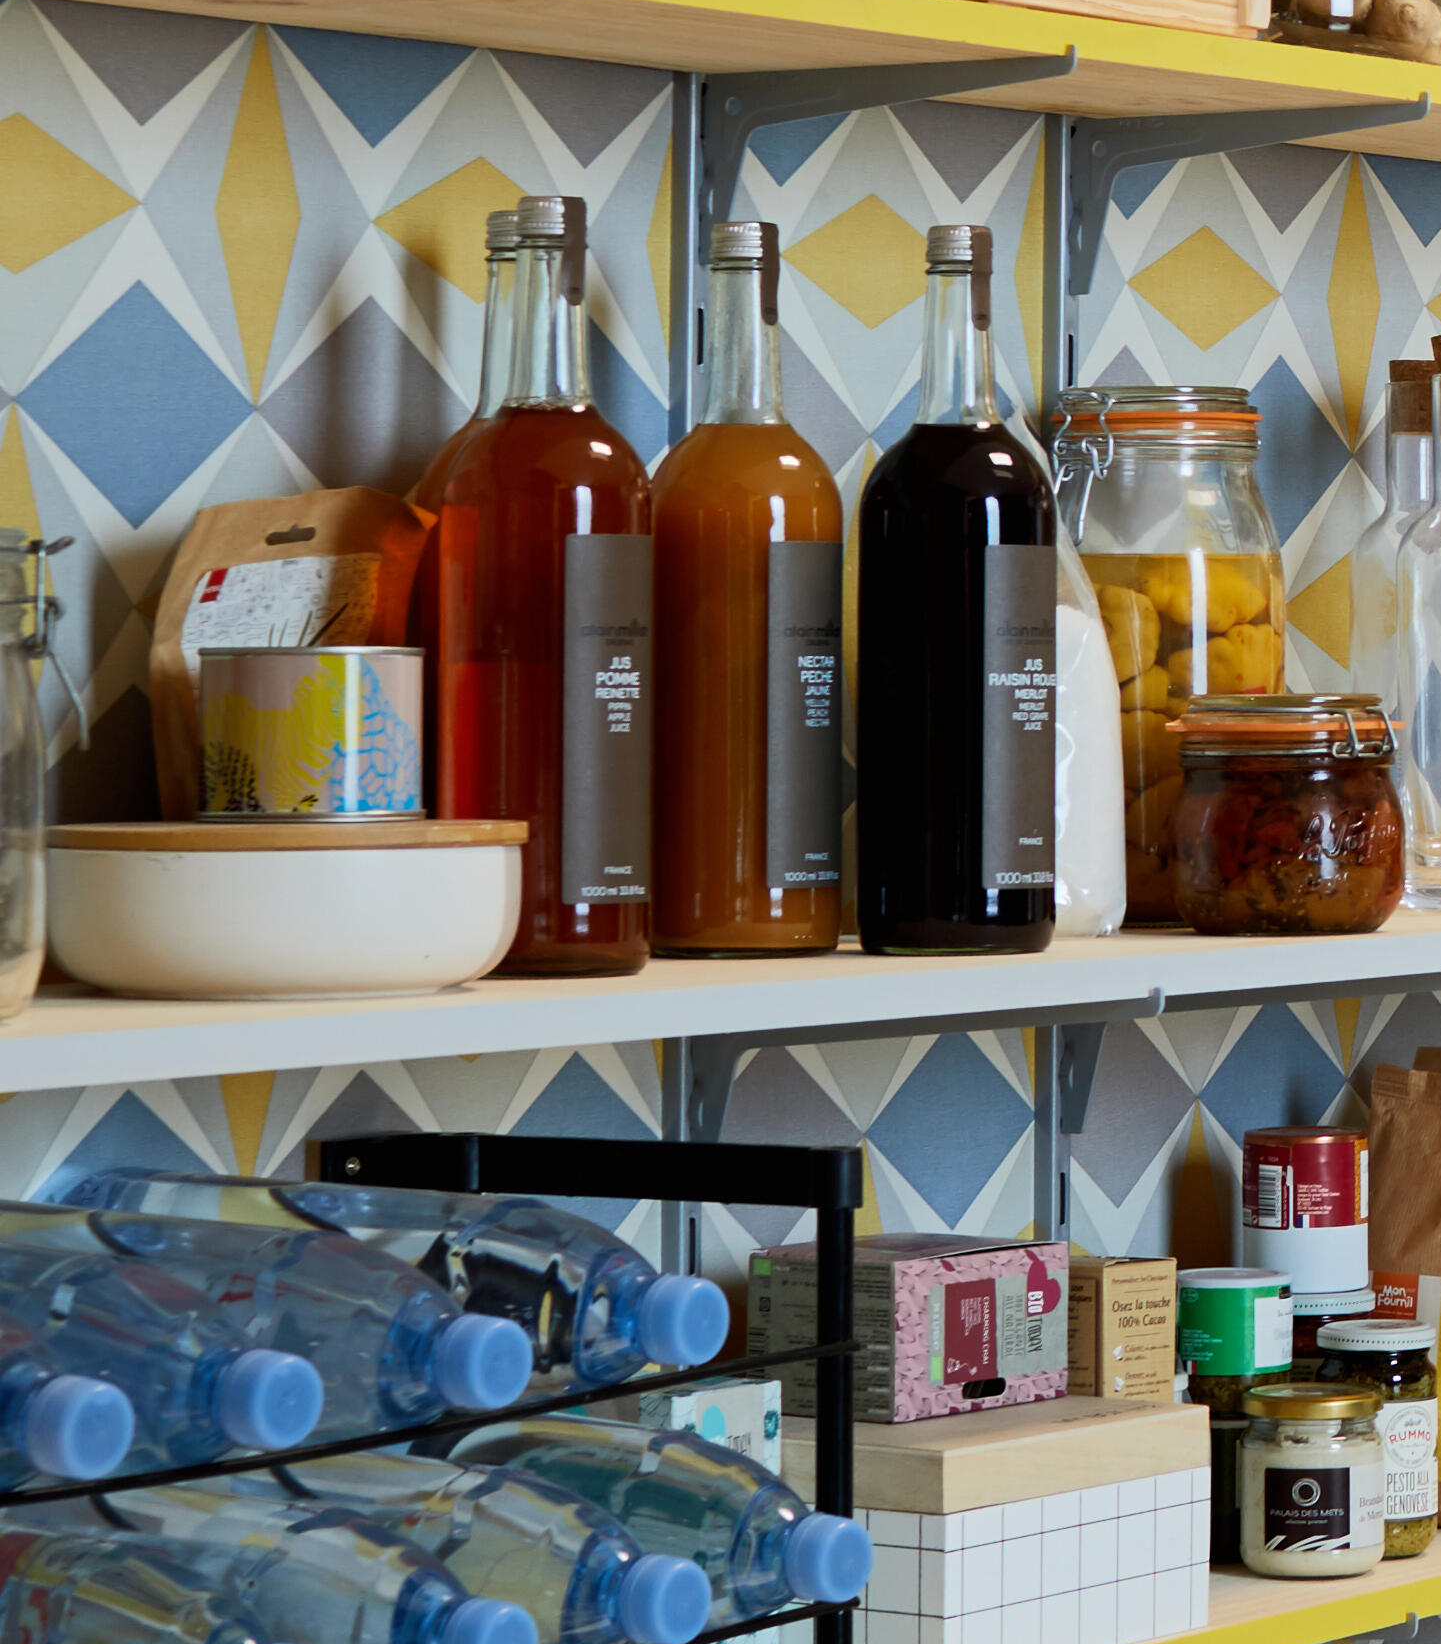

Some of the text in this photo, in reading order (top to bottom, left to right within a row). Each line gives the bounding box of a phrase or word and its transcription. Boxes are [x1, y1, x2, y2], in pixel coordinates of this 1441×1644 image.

[609, 656, 632, 670] JUS
[797, 655, 835, 669] NECTAR
[1023, 658, 1043, 671] JUS
[595, 672, 641, 686] POMME
[988, 673, 1031, 687] RAISIN
[1013, 689, 1048, 700] MERLOT
[1382, 1285, 1406, 1297] Mon
[1027, 1290, 1045, 1314] BIO
[1111, 1298, 1132, 1313] Osez
[1145, 1296, 1171, 1310] touche
[1377, 1294, 1414, 1308] Fournil
[1117, 1313, 1167, 1329] 100% Cacao
[1389, 1429, 1432, 1444] RUMMO
[1386, 1471, 1415, 1493] PESTO
[1386, 1492, 1430, 1516] GENOVESE
[1269, 1507, 1345, 1517] PALAIS DES METS
